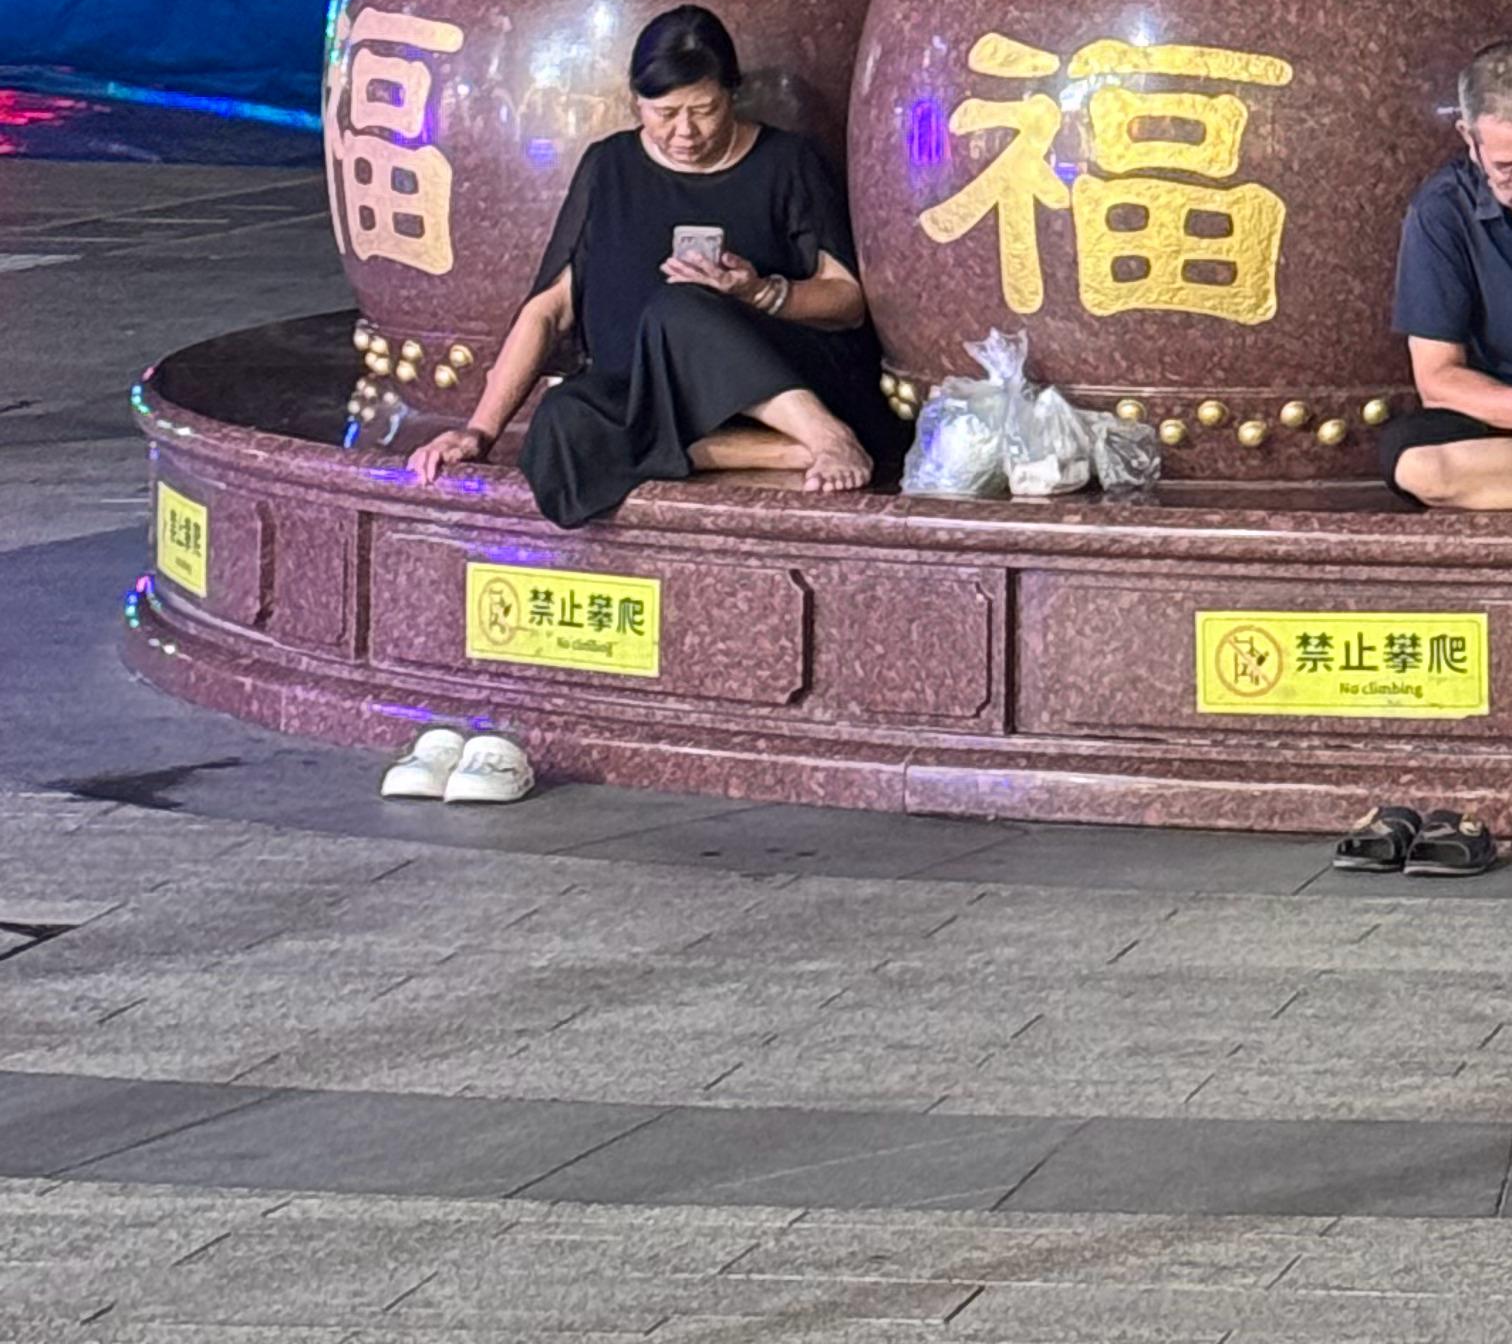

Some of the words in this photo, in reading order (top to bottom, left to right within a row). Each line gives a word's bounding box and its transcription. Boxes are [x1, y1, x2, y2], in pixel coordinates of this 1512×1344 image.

[919, 32, 1294, 324] 福
[528, 586, 645, 636] 禁止攀爬
[1295, 632, 1468, 674] 禁止攀爬
[1339, 682, 1359, 695] No
[1362, 682, 1423, 698] climbing
